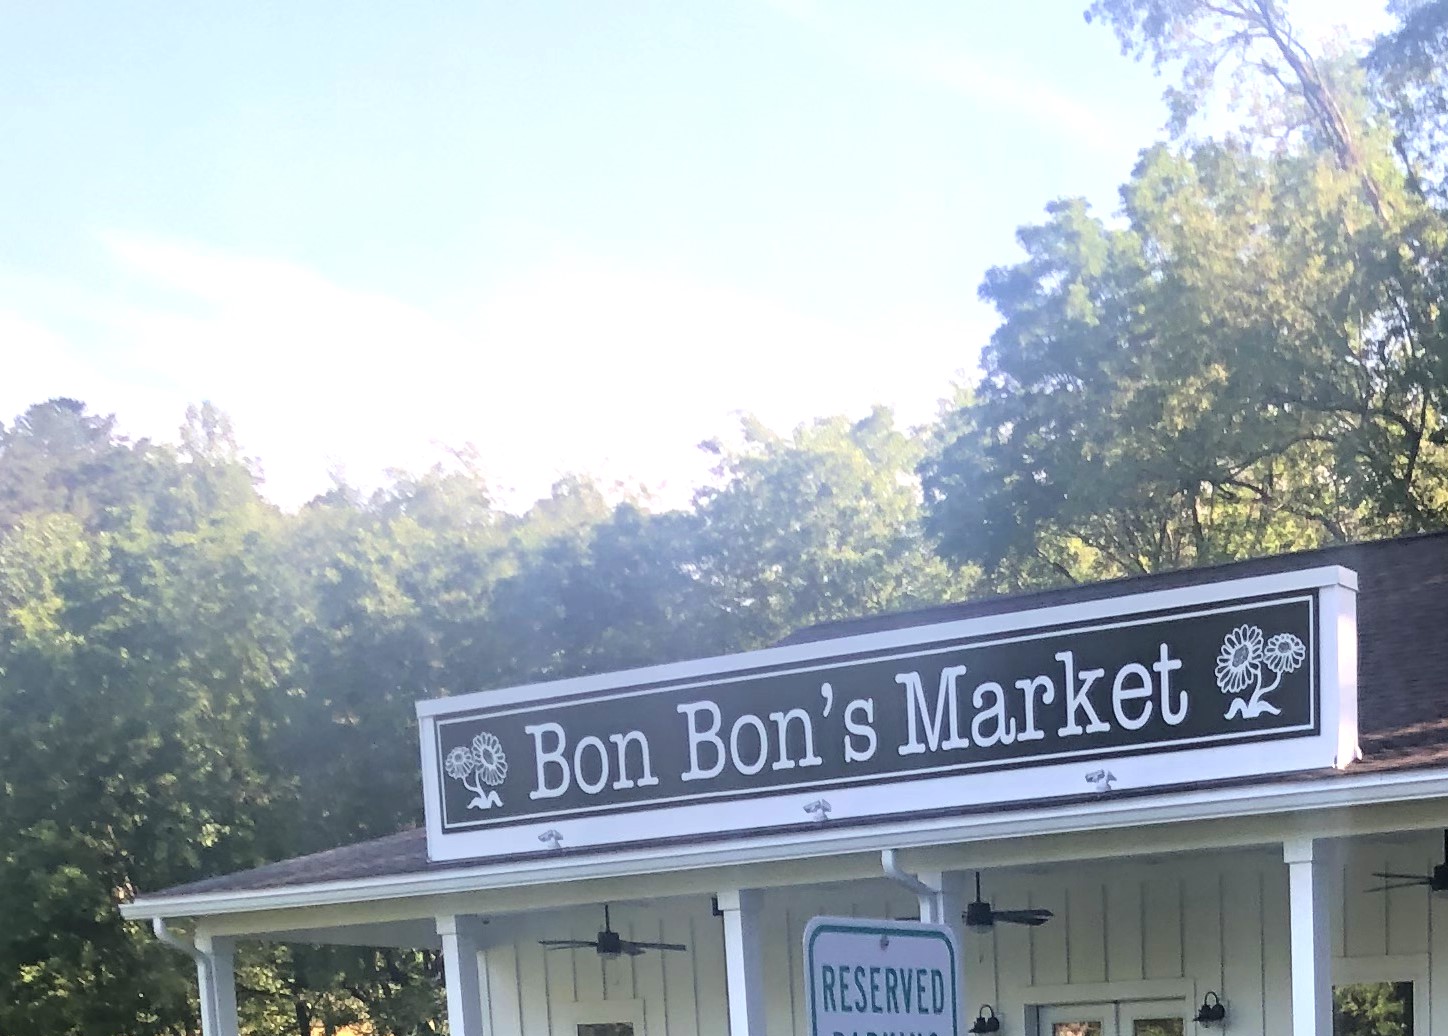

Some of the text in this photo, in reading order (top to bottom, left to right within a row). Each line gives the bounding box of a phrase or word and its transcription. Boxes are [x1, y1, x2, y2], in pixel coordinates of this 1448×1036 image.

[524, 642, 1188, 800] Bon Bon's Market
[822, 965, 944, 1014] RESERVED
